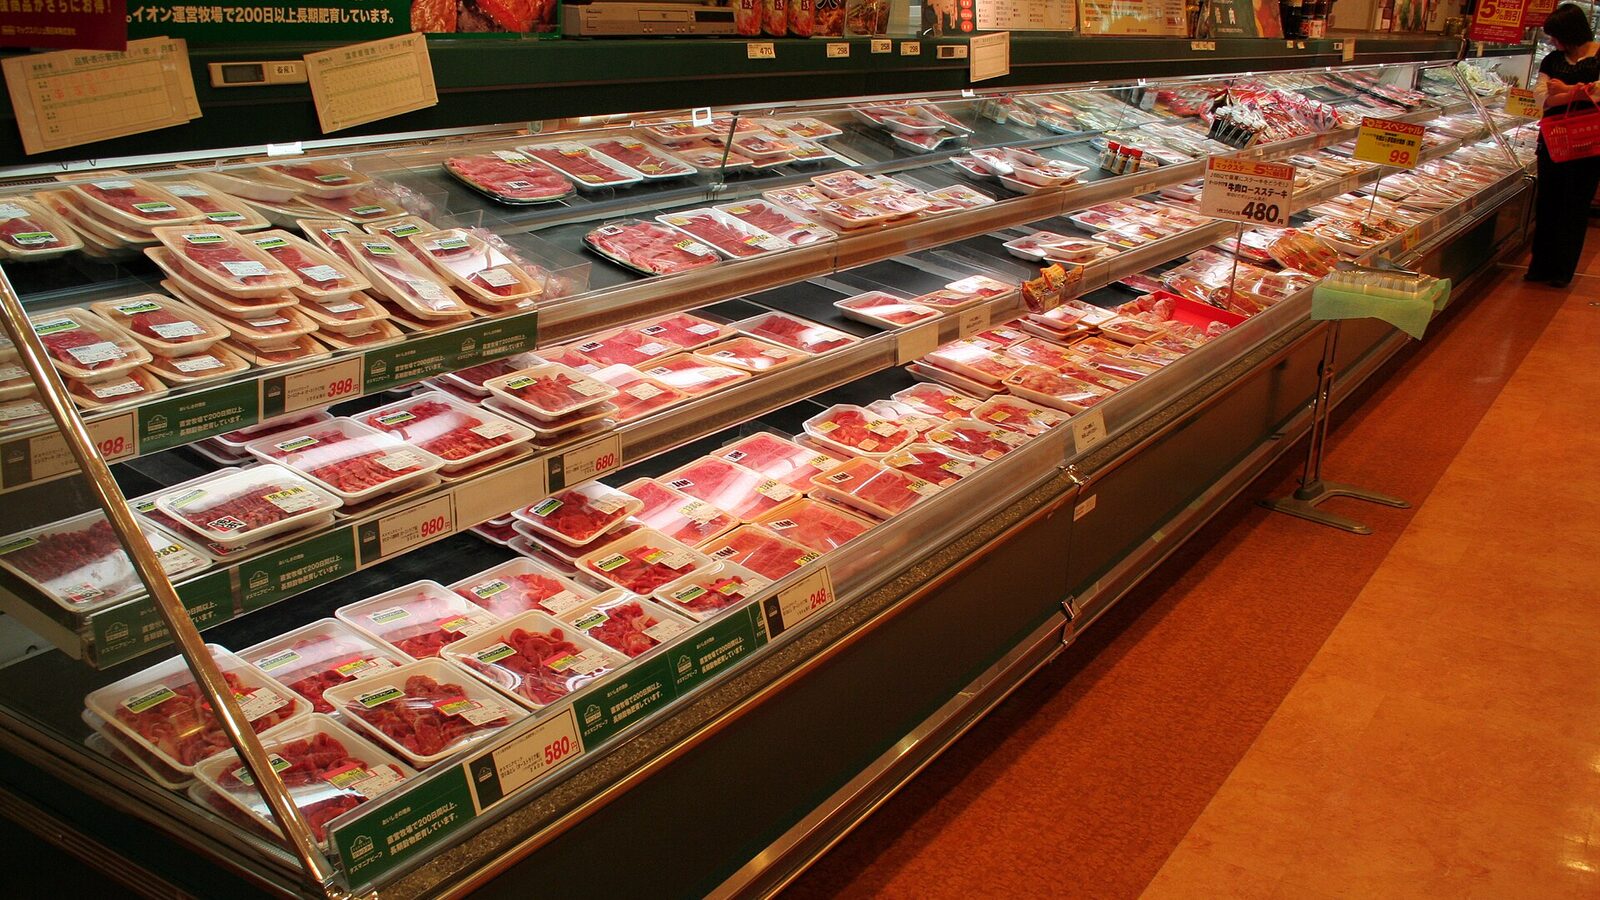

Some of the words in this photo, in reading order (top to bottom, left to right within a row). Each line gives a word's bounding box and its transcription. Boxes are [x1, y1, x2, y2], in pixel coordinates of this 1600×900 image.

[1228, 183, 1288, 199] 牛肉ロースステーキ
[544, 736, 578, 765] 580円
